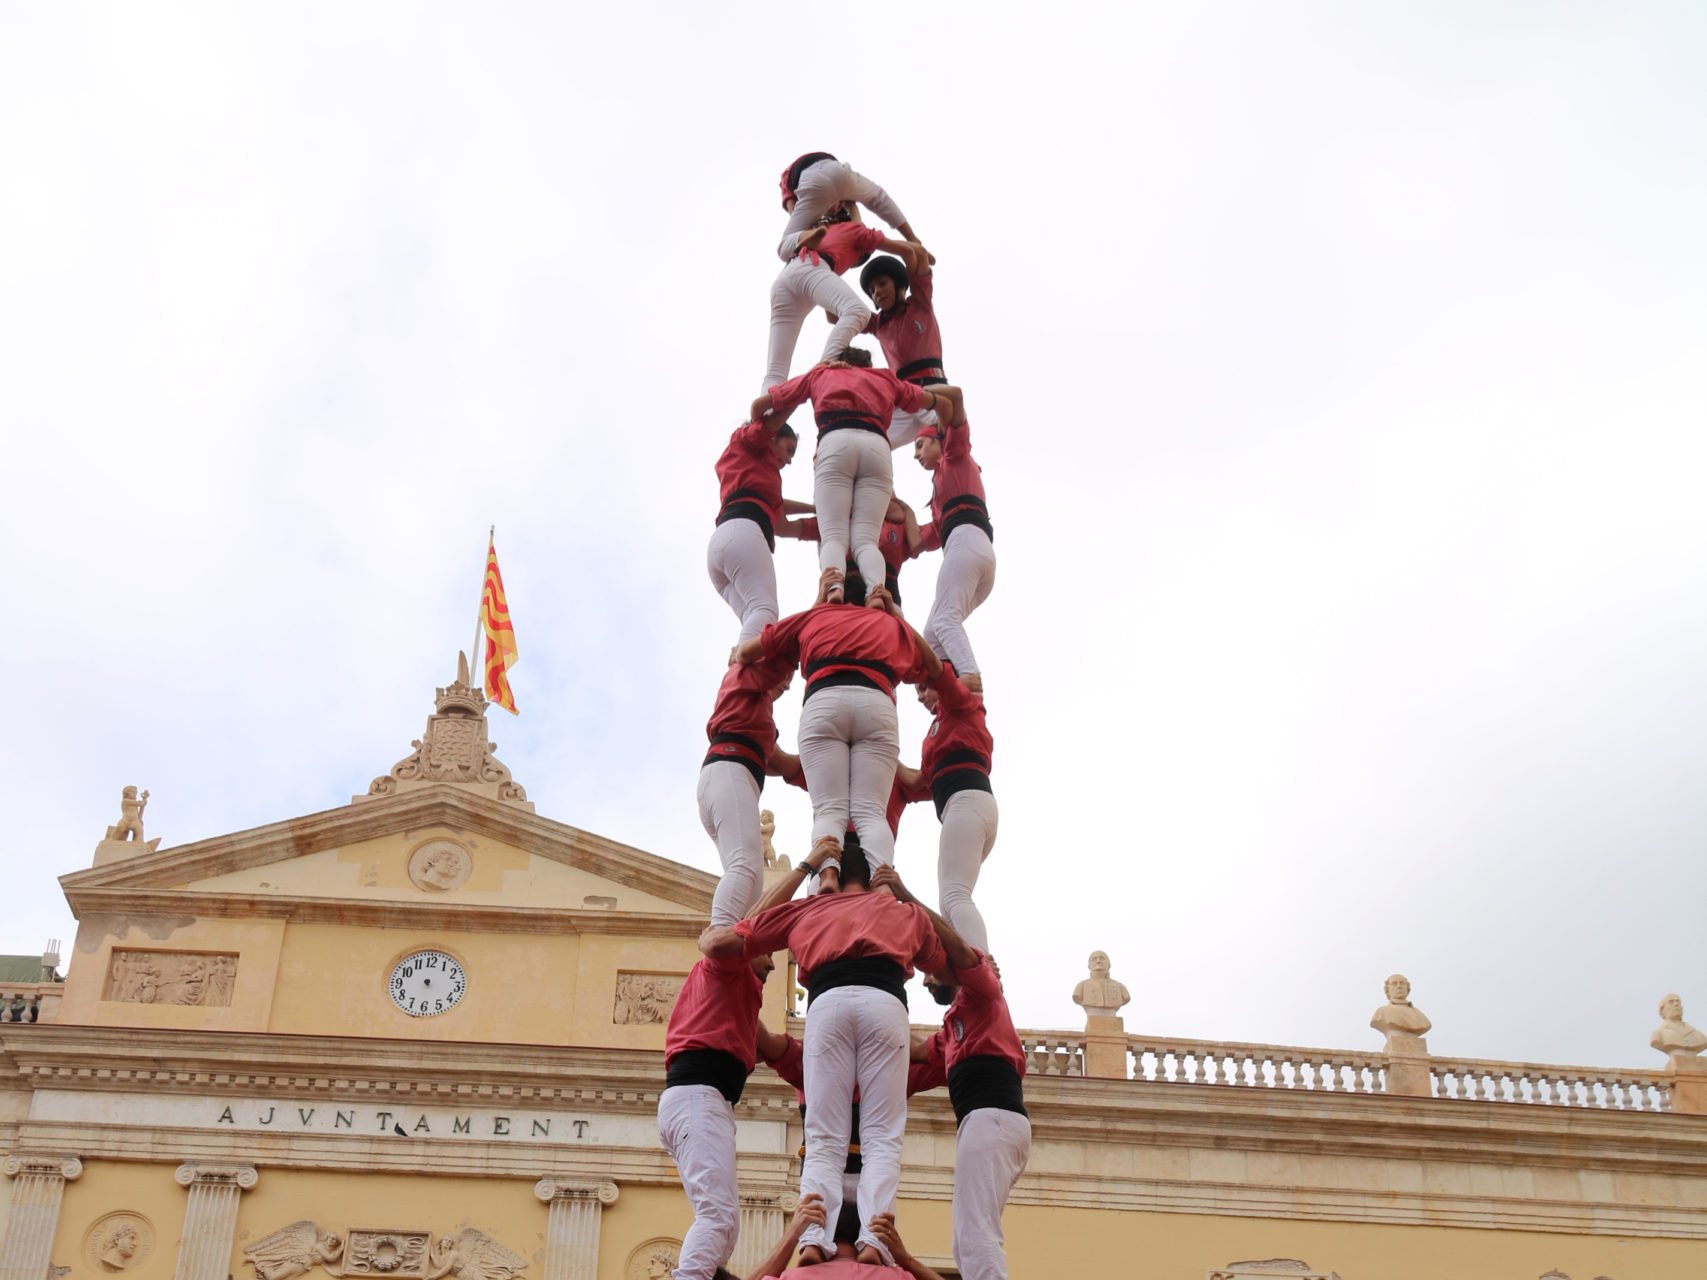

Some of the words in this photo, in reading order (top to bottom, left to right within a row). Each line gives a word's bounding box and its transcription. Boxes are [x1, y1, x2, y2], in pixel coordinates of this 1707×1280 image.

[414, 959, 422, 970] 11
[426, 956, 438, 968] 12
[442, 961, 446, 972] 1
[402, 967, 413, 978] 10
[450, 968, 457, 979] 2
[395, 978, 403, 989] 9
[454, 981, 461, 992] 3
[399, 989, 405, 1000] 8
[446, 992, 453, 1003] 4
[409, 998, 415, 1008] 7
[420, 1001, 428, 1012] 6
[435, 999, 442, 1010] 5
[217, 1105, 590, 1139] AJVNTAMENT
